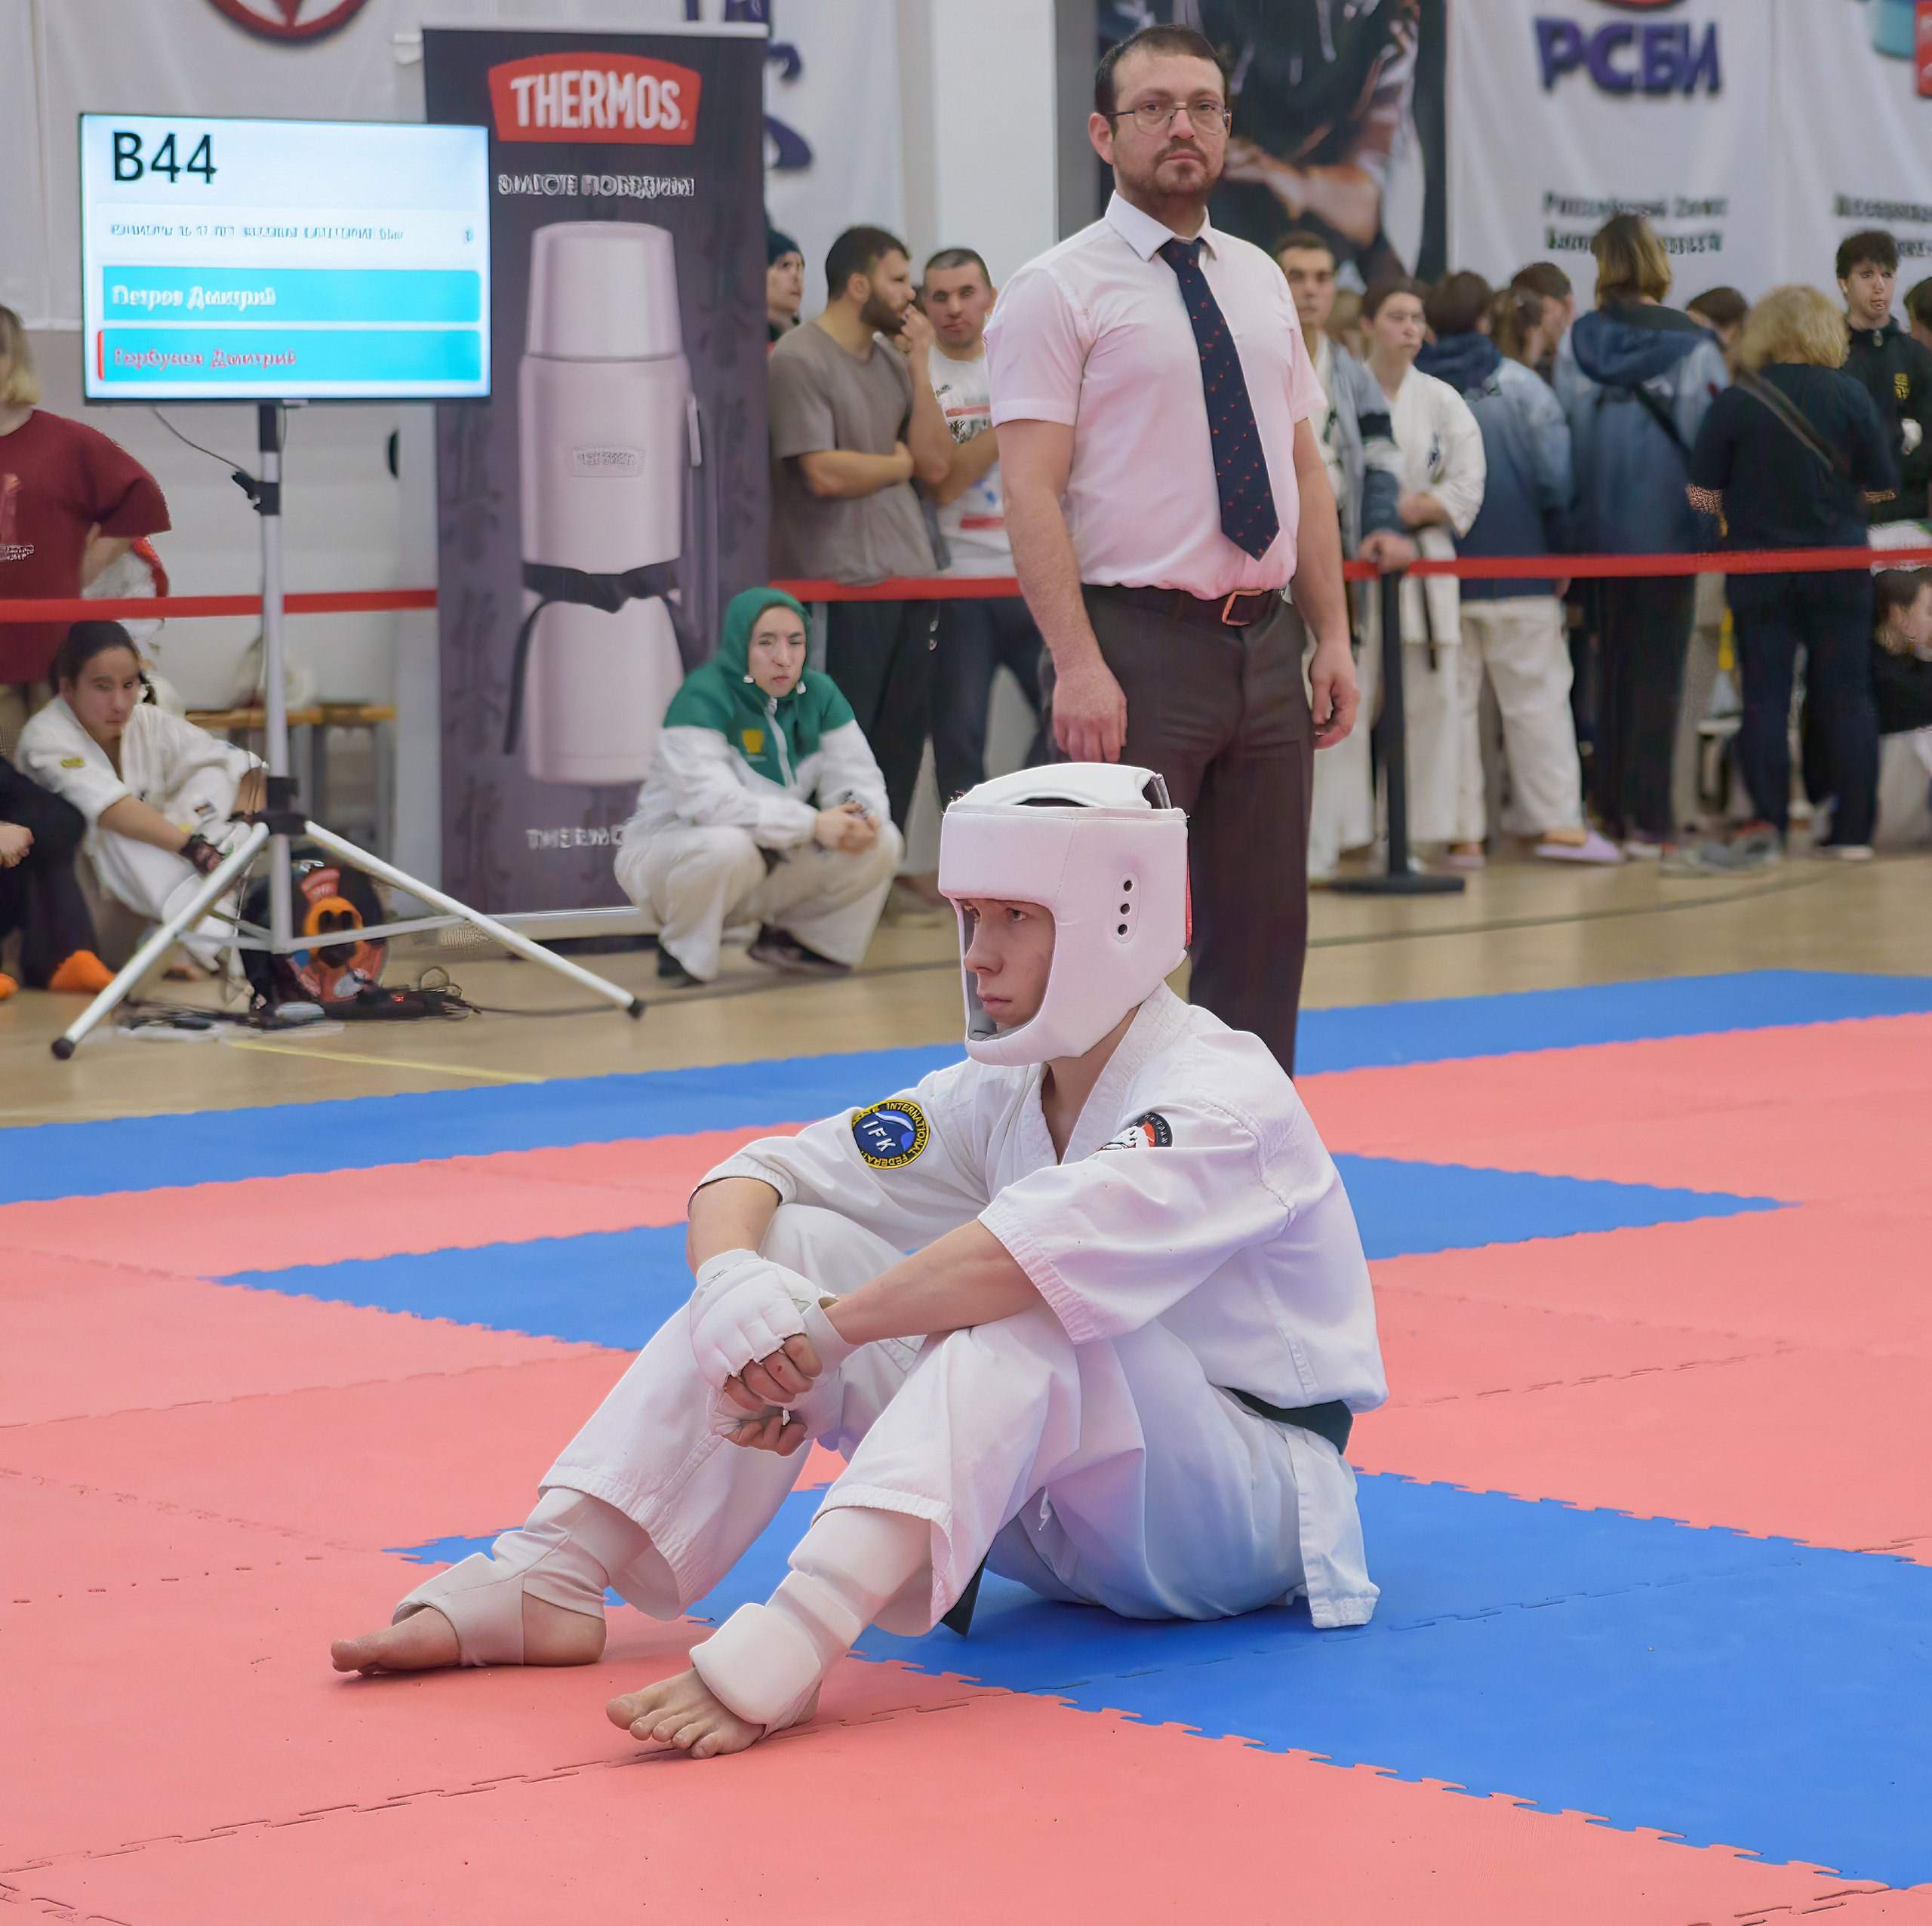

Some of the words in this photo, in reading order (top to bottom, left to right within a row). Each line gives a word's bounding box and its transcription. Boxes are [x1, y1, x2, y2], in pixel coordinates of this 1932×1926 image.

[1534, 17, 1722, 95] РСБИ
[510, 69, 681, 130] THERMOS
[112, 131, 217, 183] B44
[863, 1121, 896, 1152] IFK
[887, 1103, 926, 1155] INTERNATIONAL
